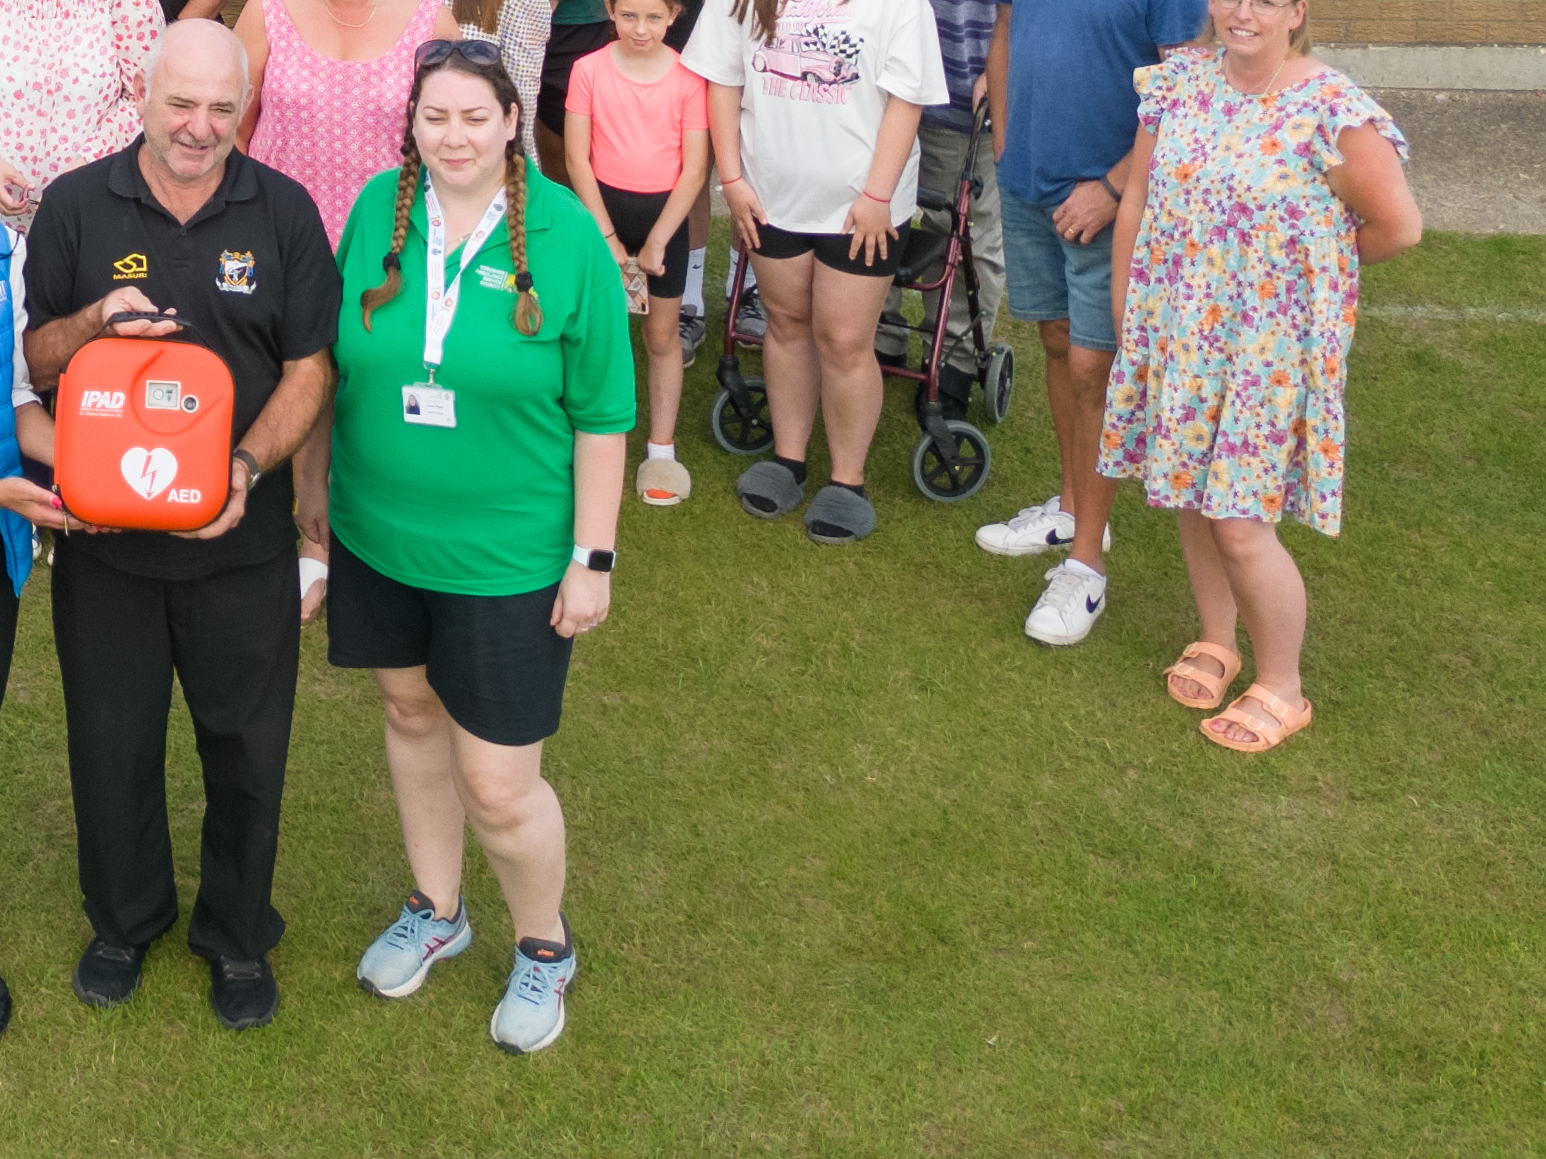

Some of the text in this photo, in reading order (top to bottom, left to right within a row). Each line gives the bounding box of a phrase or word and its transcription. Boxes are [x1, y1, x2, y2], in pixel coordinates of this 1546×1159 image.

[762, 76, 852, 105] THE CLASSIC
[80, 390, 125, 409] IPAD
[167, 488, 202, 504] AED
